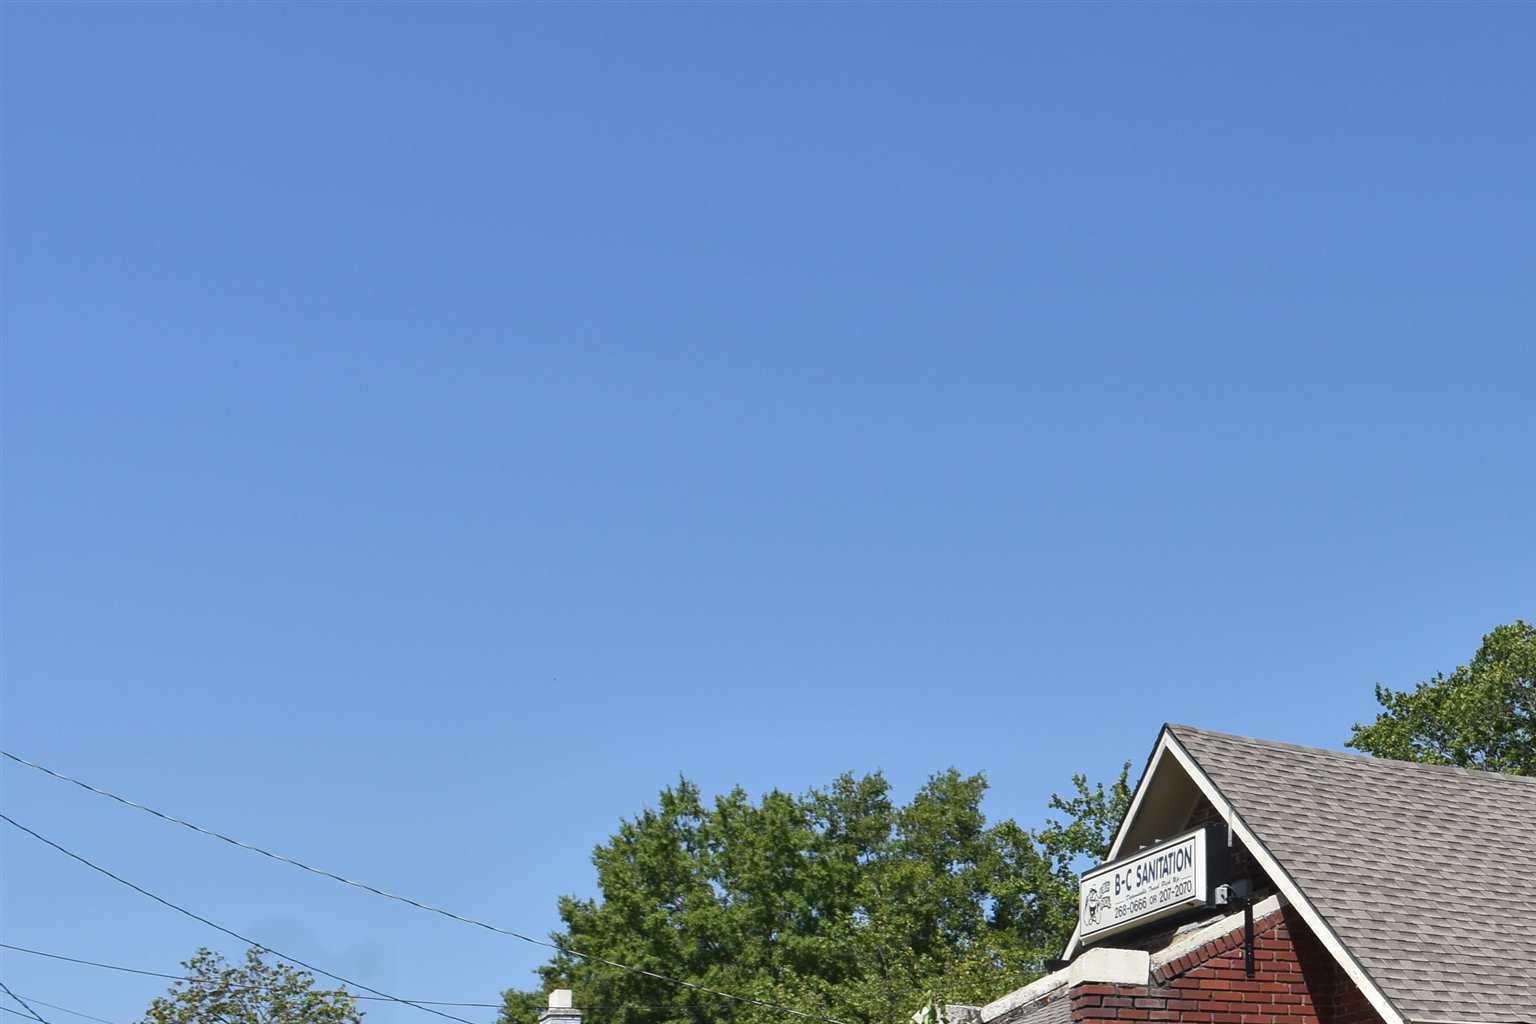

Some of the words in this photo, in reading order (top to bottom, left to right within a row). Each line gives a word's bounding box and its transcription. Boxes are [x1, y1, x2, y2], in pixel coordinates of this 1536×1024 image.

[1115, 869, 1132, 895] B-C
[1136, 845, 1192, 887] SANITATION
[1160, 880, 1192, 903] 207-2070
